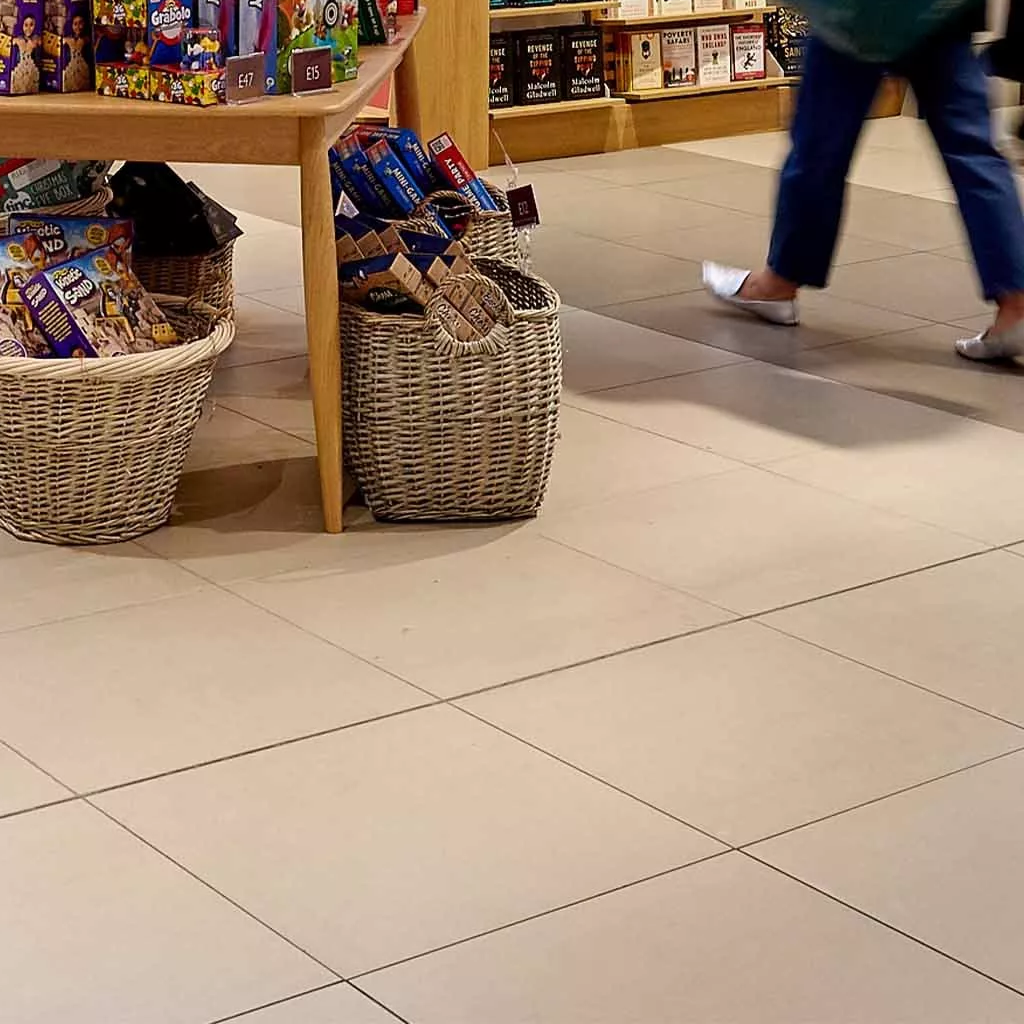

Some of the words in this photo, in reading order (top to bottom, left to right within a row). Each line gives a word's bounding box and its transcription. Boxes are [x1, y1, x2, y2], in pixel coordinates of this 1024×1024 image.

[150, 6, 191, 26] Grabolo
[663, 30, 693, 39] POVERTY
[572, 39, 598, 49] REVENGE
[666, 37, 691, 45] SAFARI
[527, 43, 553, 53] REVENGE
[306, 65, 320, 81] £15
[238, 72, 254, 89] £47
[527, 80, 556, 90] Malcolm
[571, 76, 600, 86] Malcolm
[489, 86, 508, 94] lcolm
[526, 89, 557, 100] Gladwell
[570, 85, 601, 95] Gladwell
[489, 94, 509, 103] dwell
[443, 158, 466, 185] PARTY
[53, 184, 73, 201] BOX
[41, 239, 65, 253] ND
[55, 267, 83, 290] Kinetic
